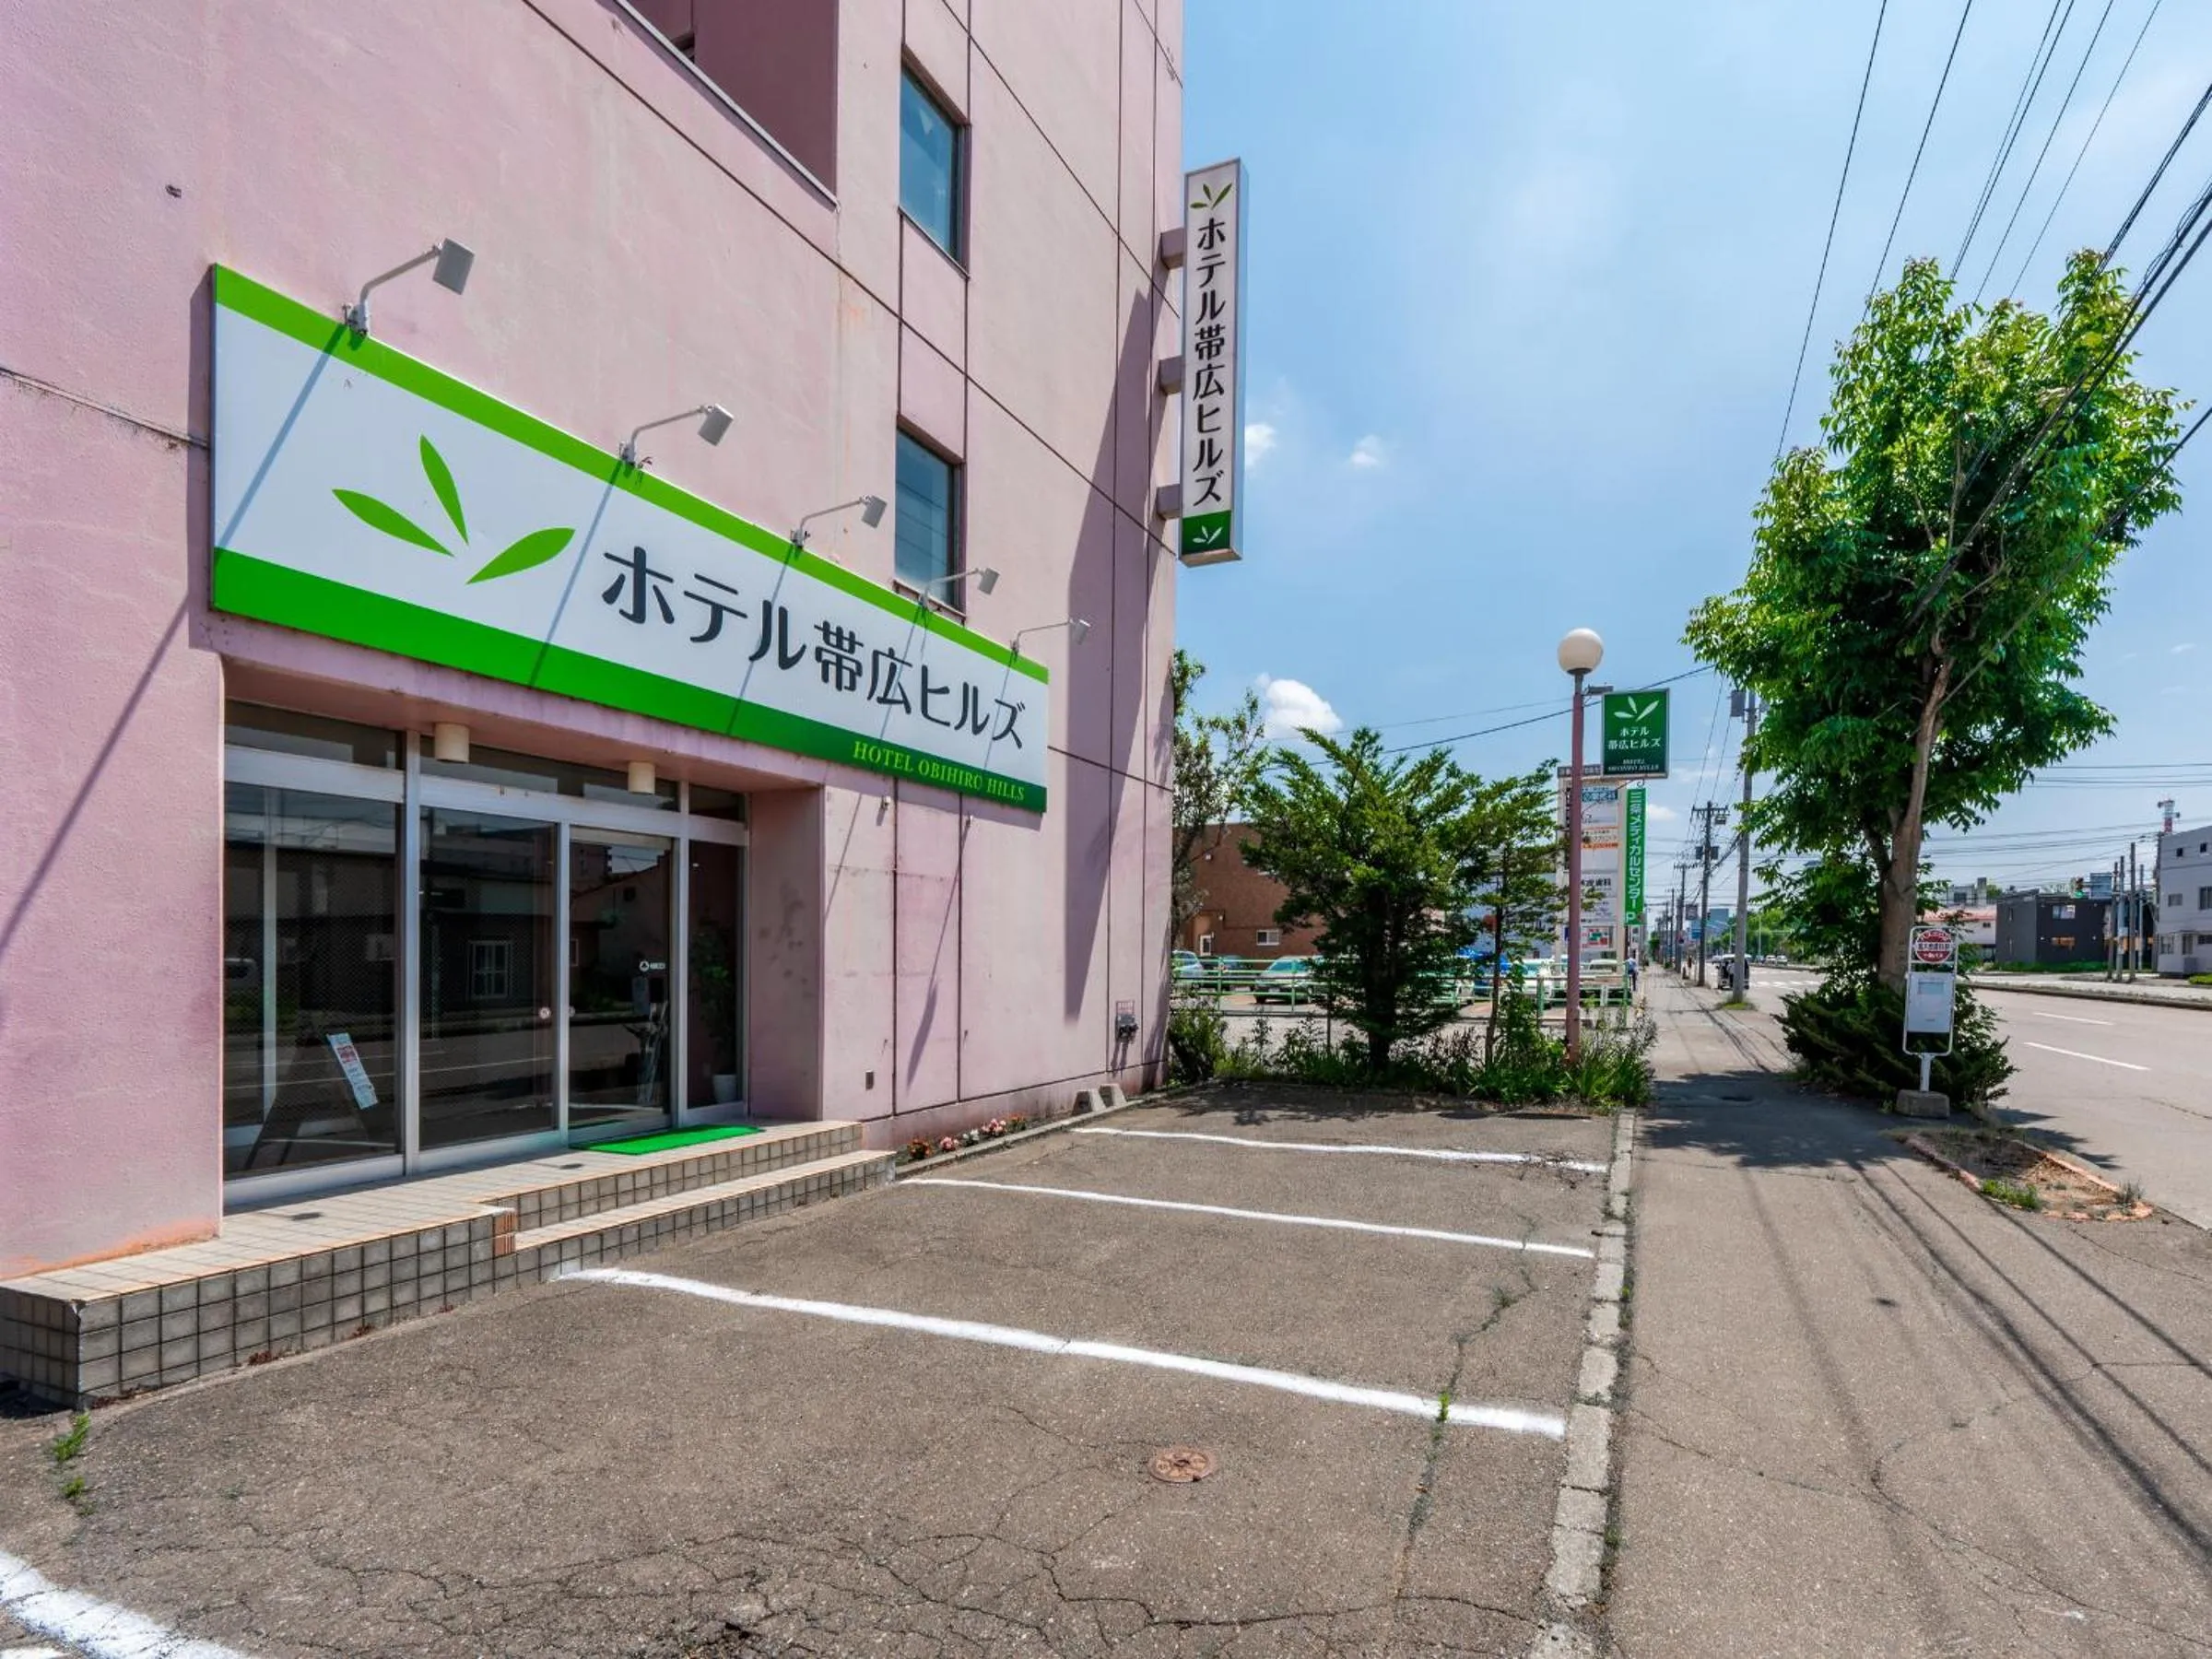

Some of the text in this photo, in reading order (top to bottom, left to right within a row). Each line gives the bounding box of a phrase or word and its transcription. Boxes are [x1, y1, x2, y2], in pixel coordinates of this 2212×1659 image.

[1193, 218, 1227, 506] ホテル帯広ヒルズ
[601, 546, 1026, 748] ホテル帯広ヒルズ
[1608, 737, 1661, 749] 帯広ヒルズ
[1619, 726, 1649, 736] ホテル
[853, 741, 1025, 801] HOTEL OBIHIRO HILLS
